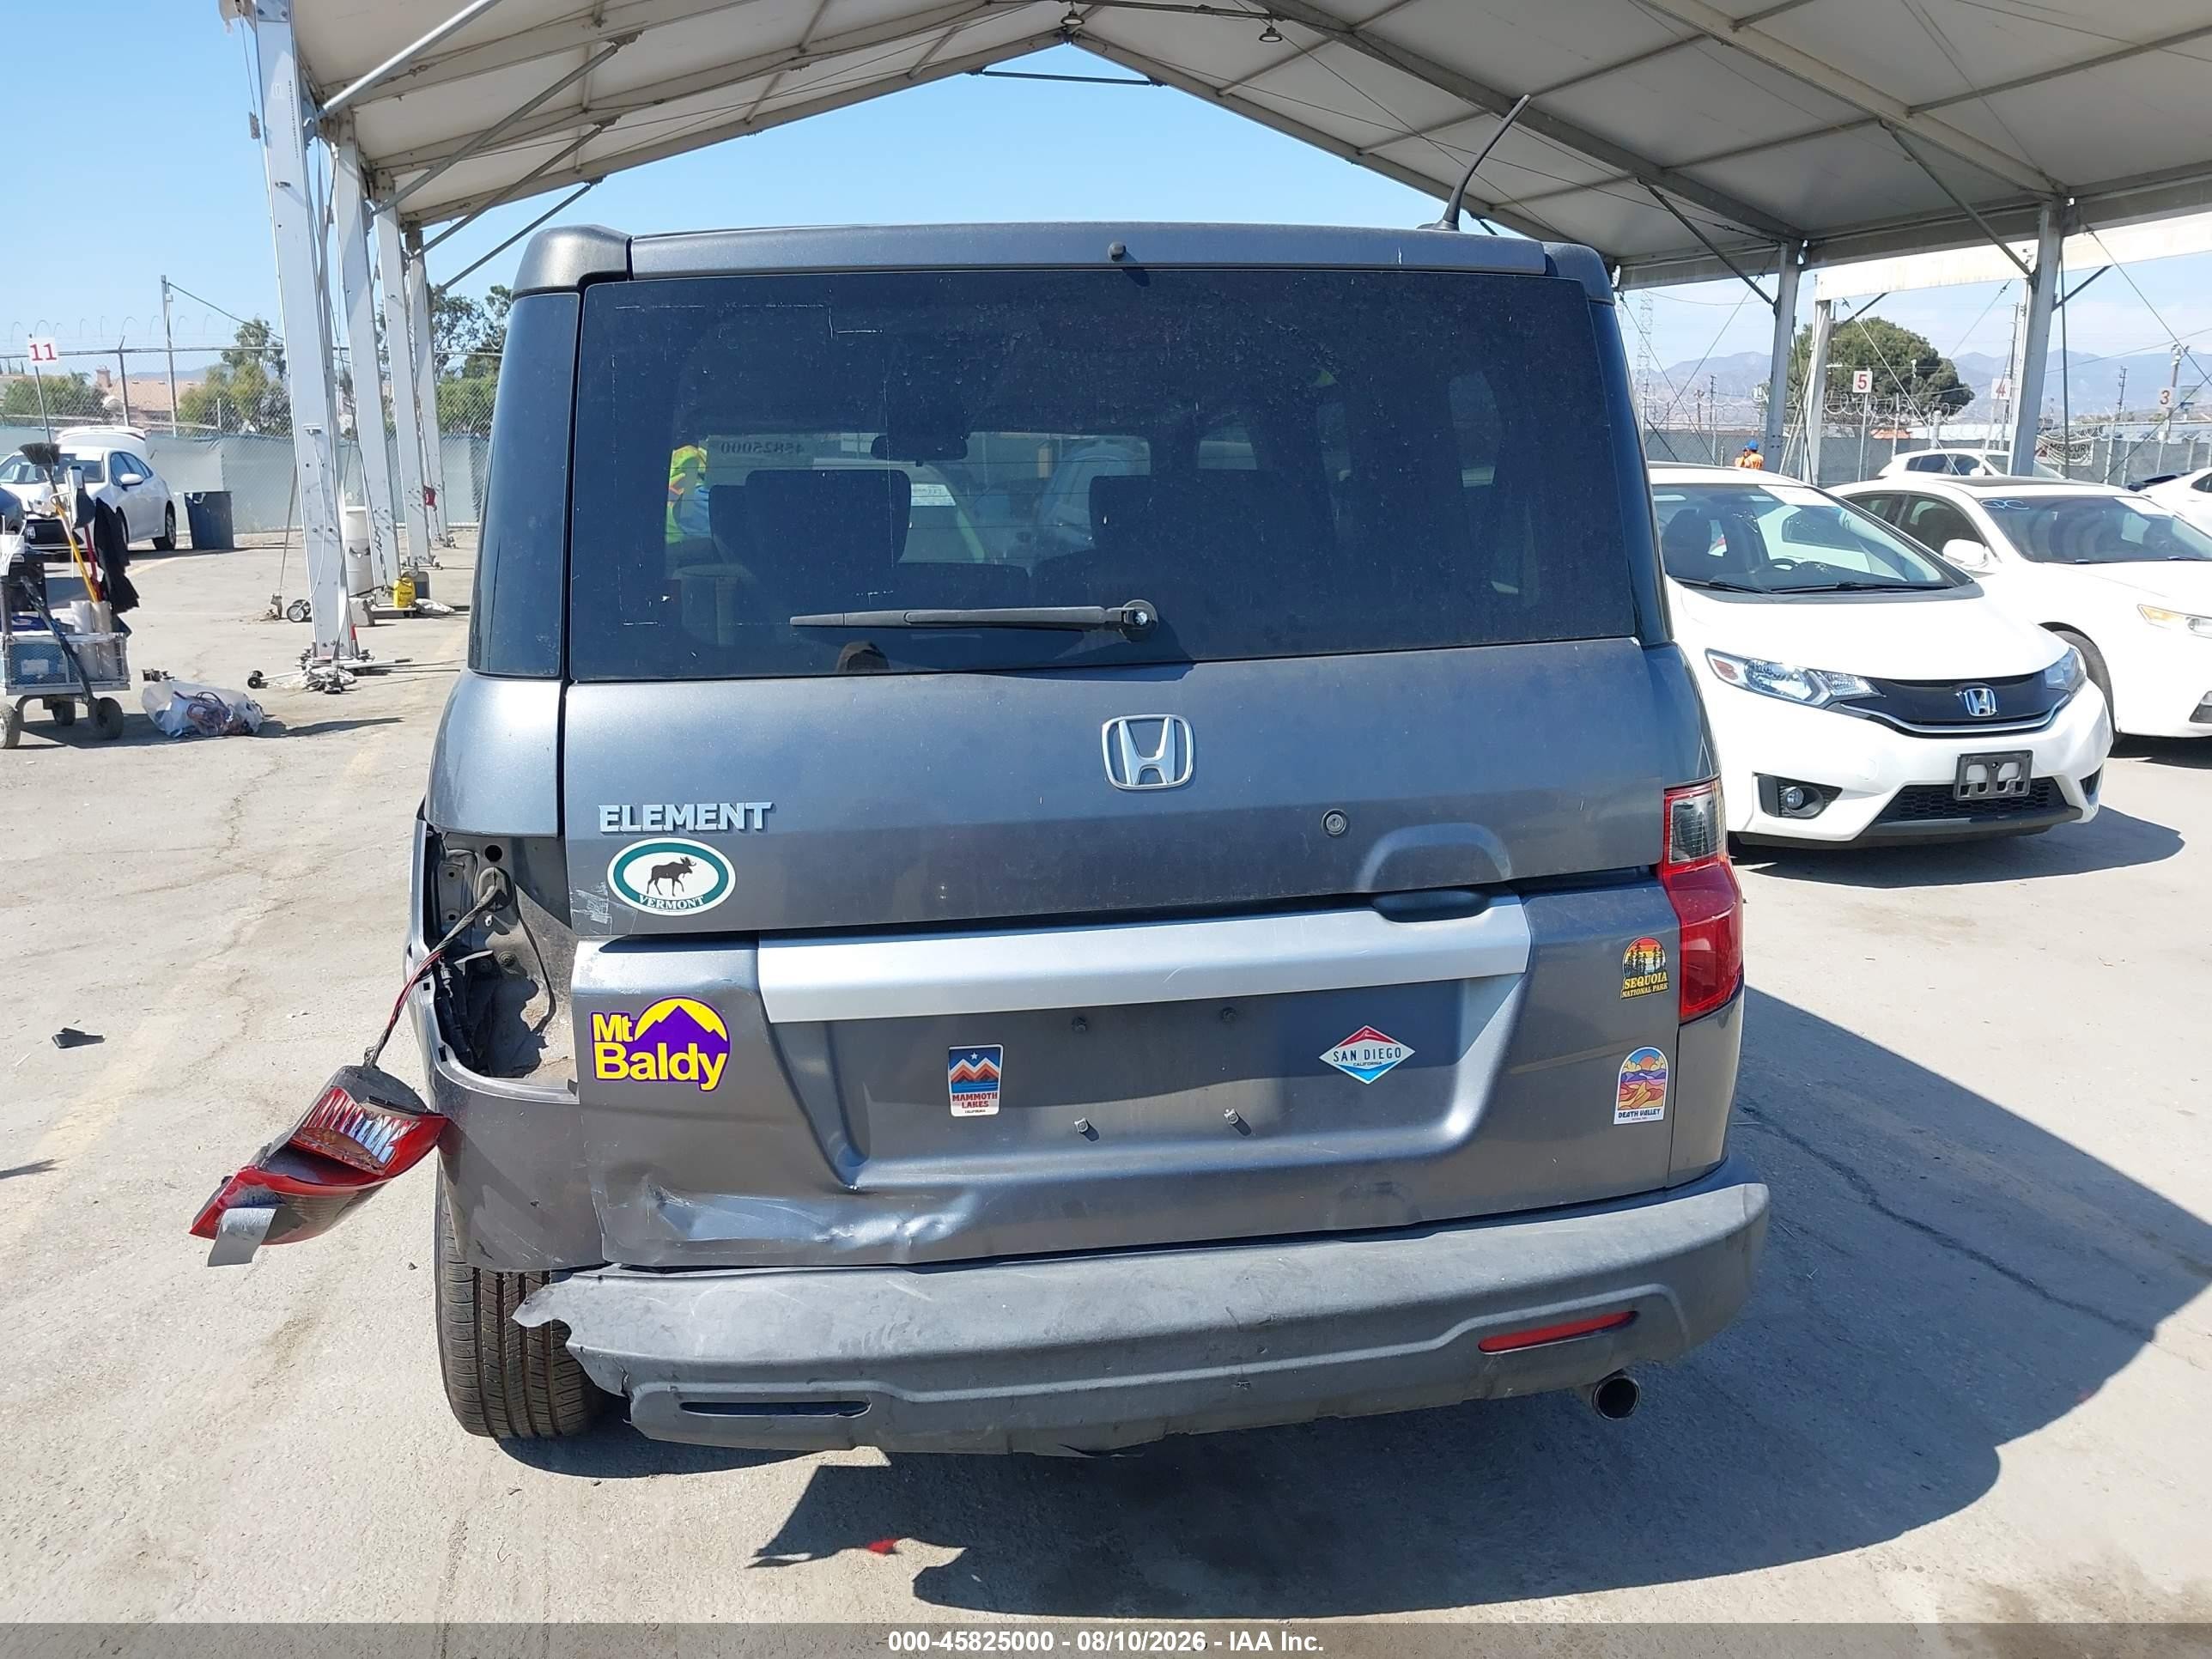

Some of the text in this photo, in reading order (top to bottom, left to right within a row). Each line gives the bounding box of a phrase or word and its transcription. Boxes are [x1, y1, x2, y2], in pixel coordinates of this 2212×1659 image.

[29, 343, 57, 362] 11
[1857, 374, 1868, 390] 5
[1996, 383, 2006, 398] 4
[2160, 390, 2171, 405] 3
[599, 801, 773, 833] ELEMENT
[639, 894, 705, 910] VERMONT
[1624, 971, 1668, 989] SEQUOIA
[1621, 982, 1668, 998] NATIONAL PARK
[592, 1013, 634, 1042] Mt
[1333, 1047, 1401, 1063] SAN DIEGO
[593, 1042, 728, 1091] Baldy
[952, 1091, 998, 1102] MAMMOTH
[961, 1100, 989, 1109] LAKES
[1618, 1110, 1639, 1119] DEATH
[1639, 1108, 1661, 1116] VALLEY
